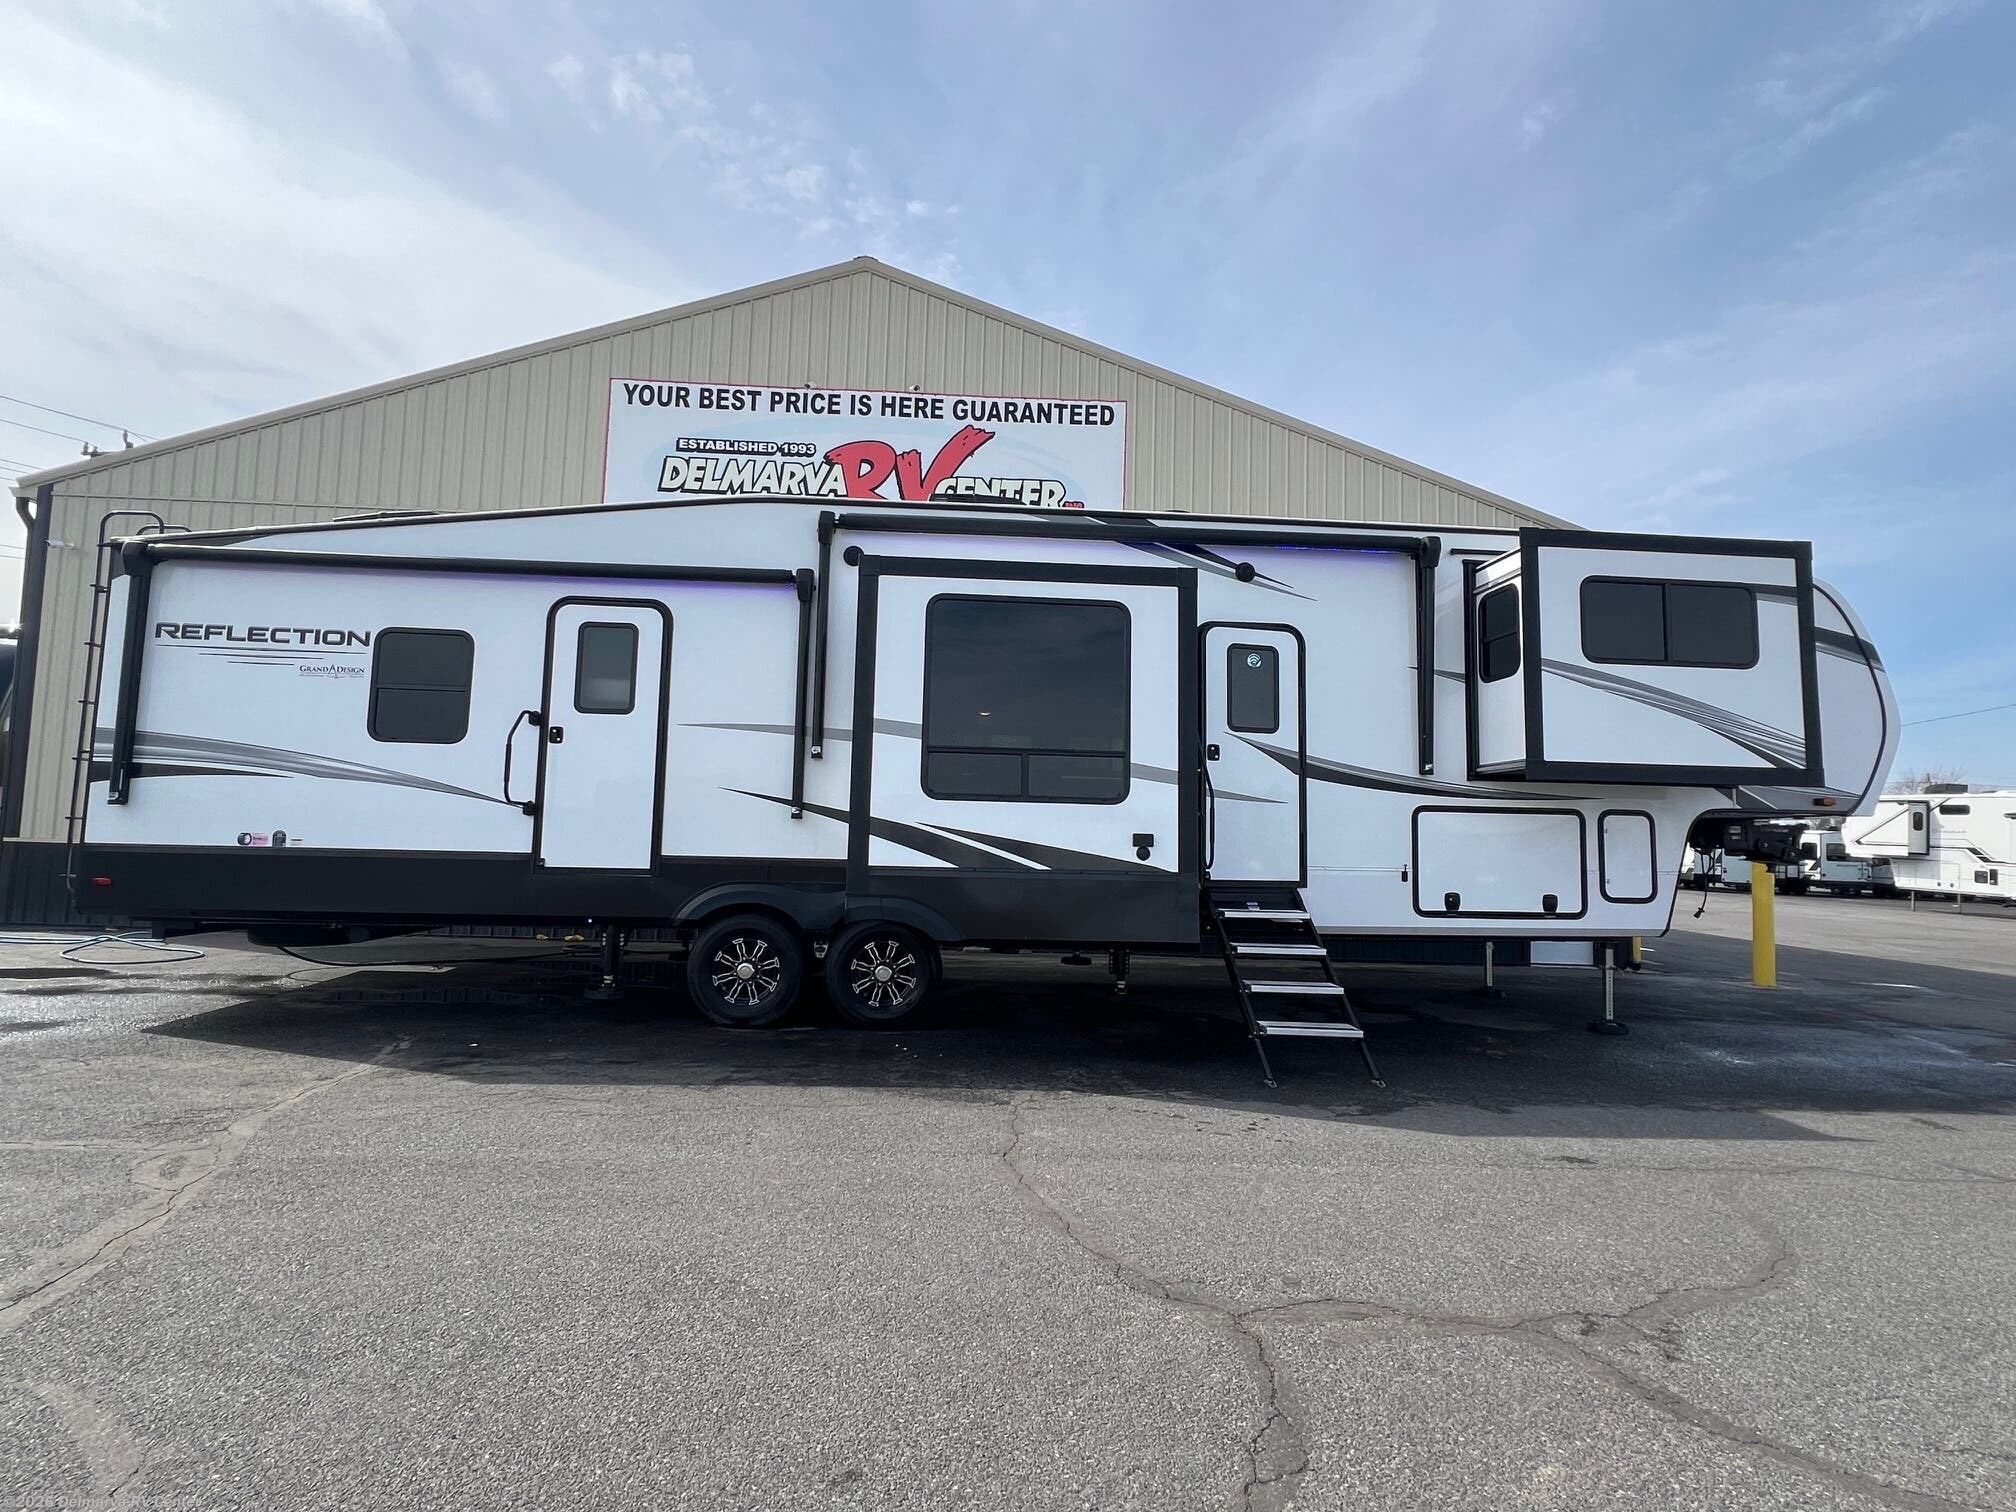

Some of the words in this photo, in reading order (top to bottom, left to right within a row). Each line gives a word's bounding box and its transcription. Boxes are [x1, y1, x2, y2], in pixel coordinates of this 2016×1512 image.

[623, 383, 690, 408] YOUR
[699, 387, 762, 412] BEST
[769, 391, 842, 415] PRICE
[850, 394, 872, 416] IS
[880, 396, 944, 419] HERE
[952, 399, 1115, 426] GUARANTEED
[678, 438, 779, 454] ESTABLISHED
[781, 442, 816, 455] 1993
[658, 455, 848, 497] DELMARVA
[823, 425, 996, 501] RV
[933, 476, 1066, 508] CENTER
[155, 622, 372, 647] REFLECTION
